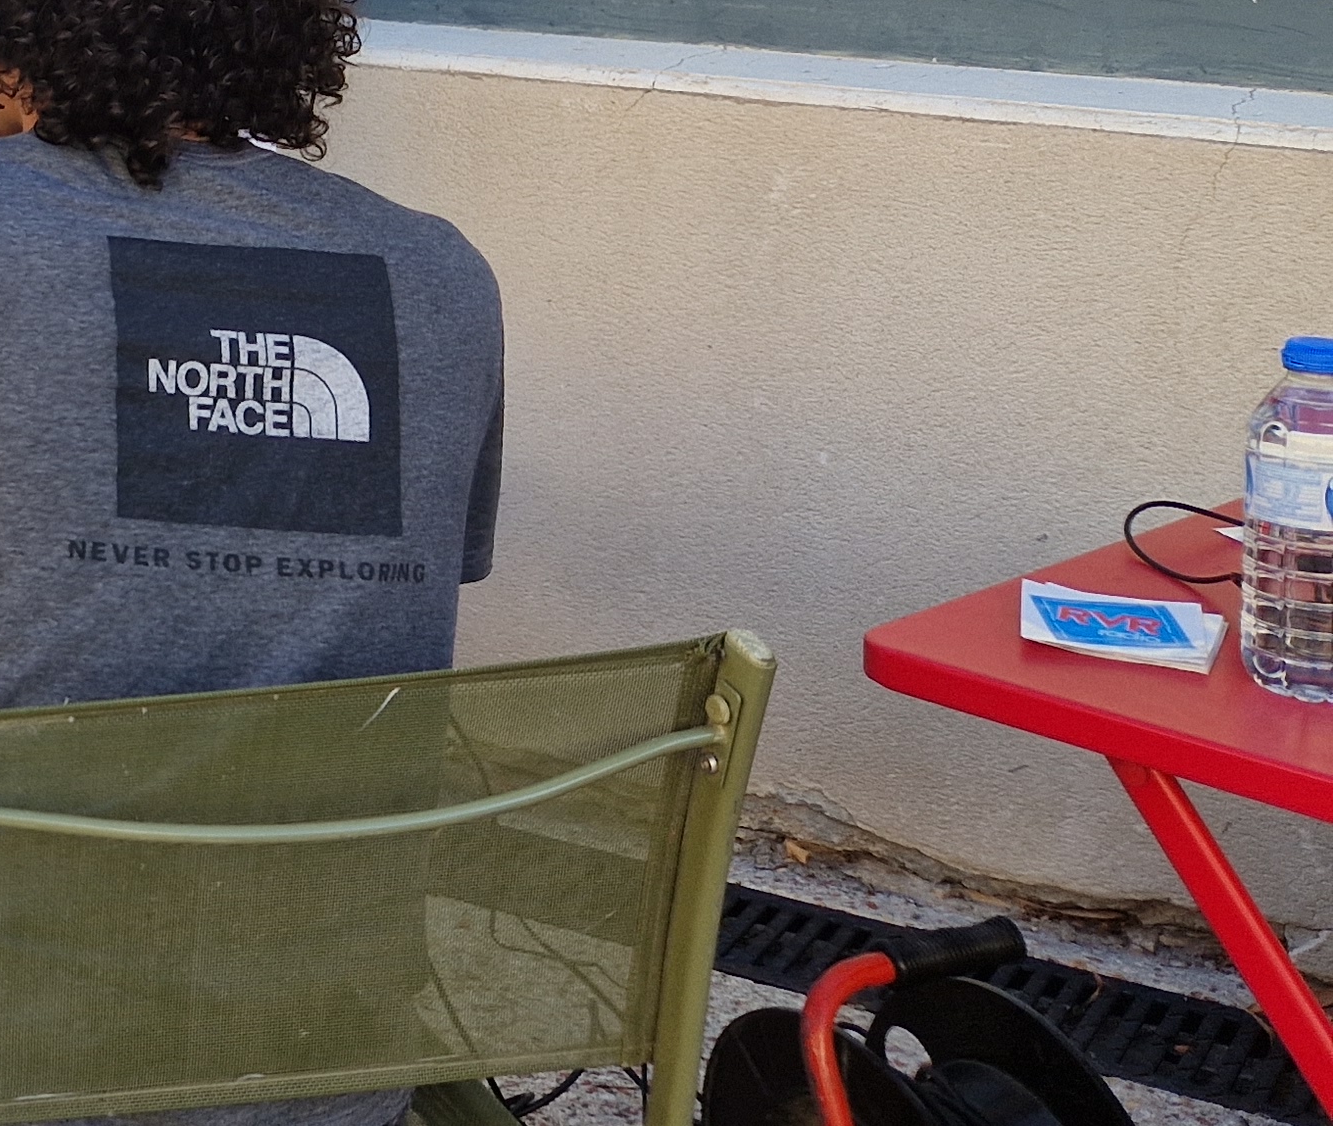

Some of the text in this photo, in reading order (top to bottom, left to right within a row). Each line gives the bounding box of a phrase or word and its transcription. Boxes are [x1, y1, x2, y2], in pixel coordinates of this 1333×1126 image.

[210, 328, 291, 367] THE
[147, 358, 291, 402] NORTH
[188, 396, 291, 438] FACE
[67, 539, 426, 584] NEVER STOP EXPLORING
[1055, 605, 1163, 636] RVR
